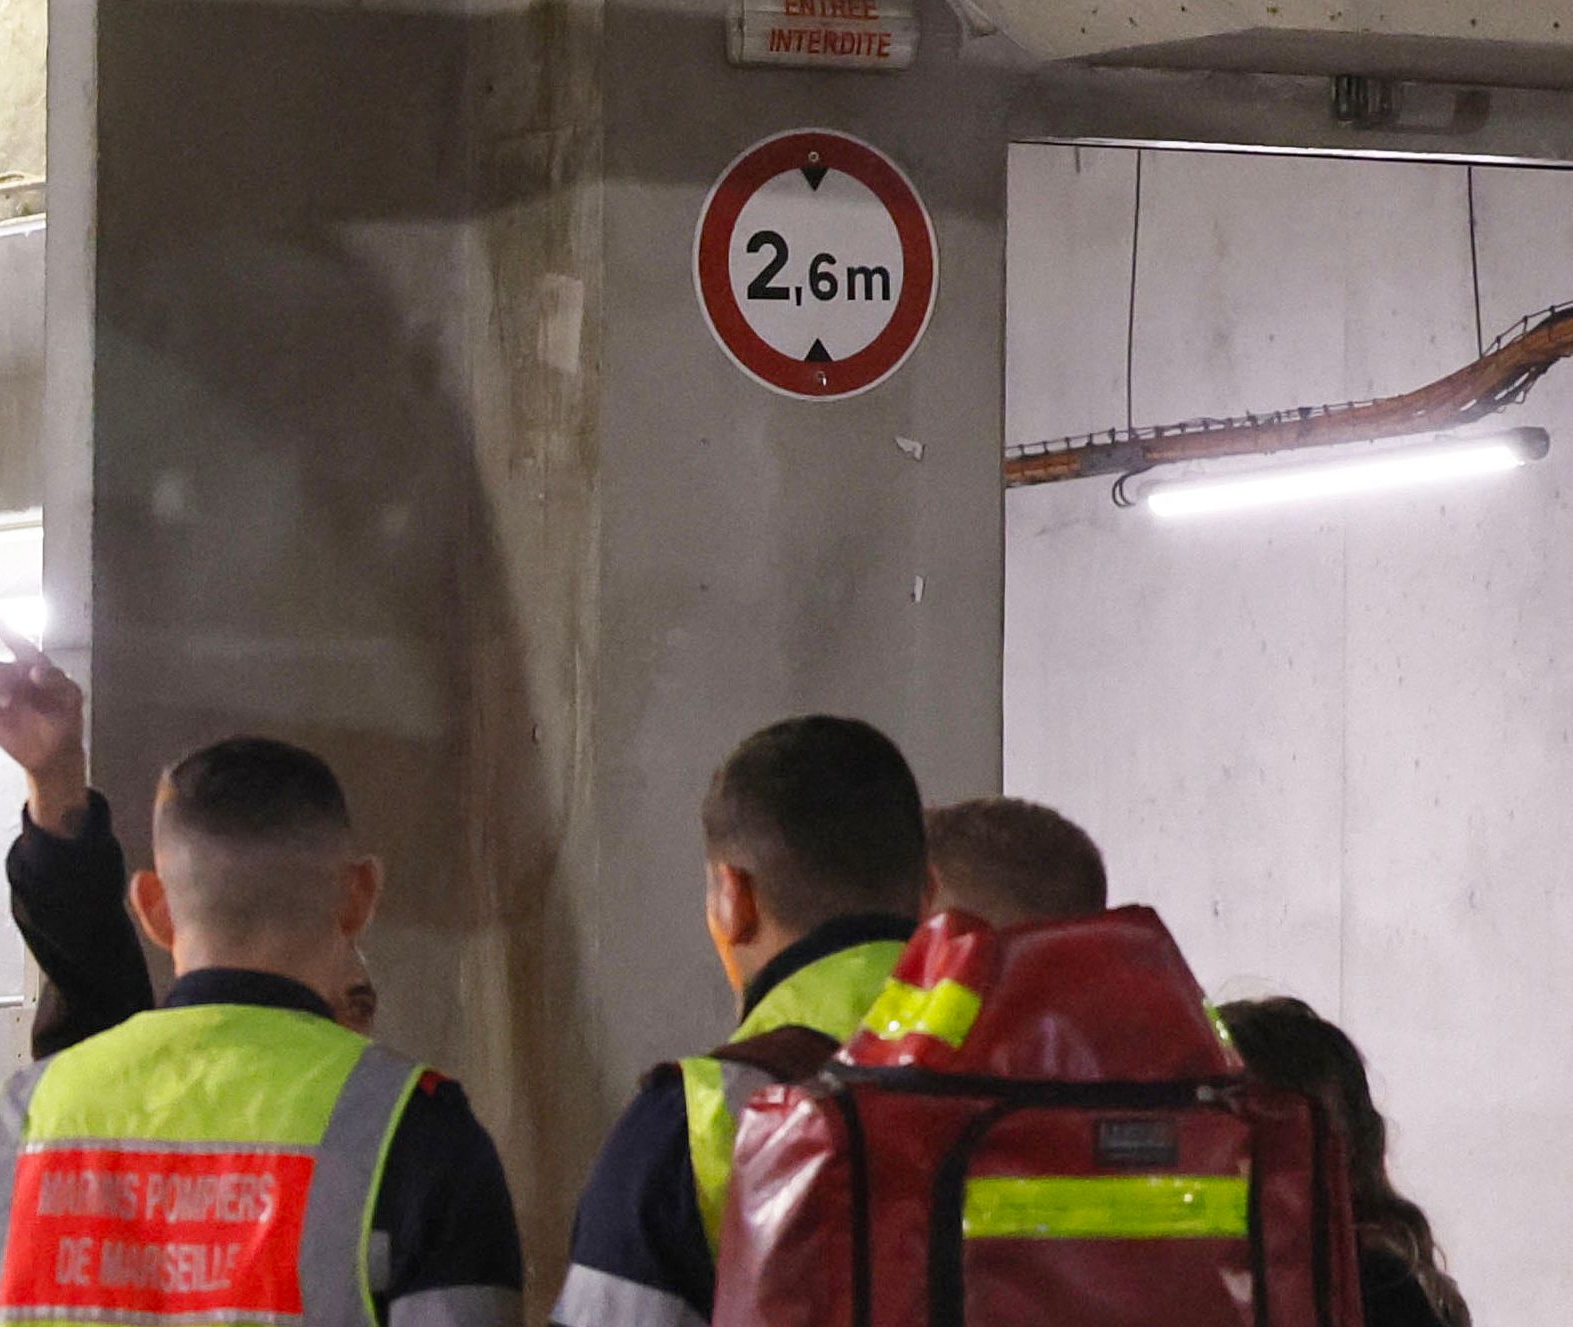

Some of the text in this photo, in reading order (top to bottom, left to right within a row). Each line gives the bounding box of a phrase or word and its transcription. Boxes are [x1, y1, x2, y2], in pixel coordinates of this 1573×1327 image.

[768, 28, 892, 57] INTERDITE
[144, 1171, 278, 1225] POMPIERS
[55, 1236, 94, 1286] DE
